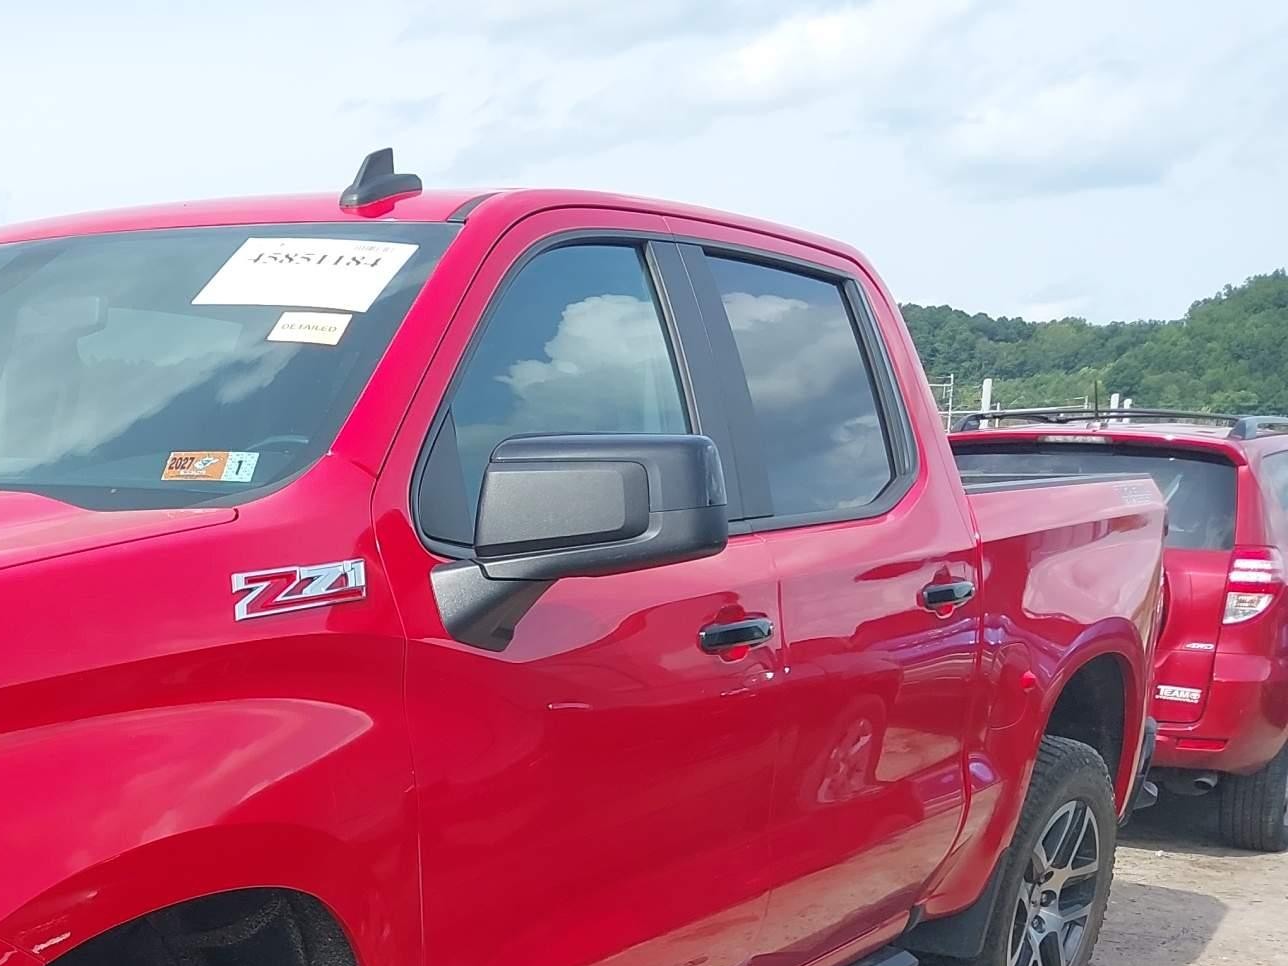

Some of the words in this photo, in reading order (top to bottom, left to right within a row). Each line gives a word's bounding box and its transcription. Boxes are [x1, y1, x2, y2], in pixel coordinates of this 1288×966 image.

[248, 252, 382, 268] 45851184
[281, 323, 337, 333] DETAILED
[168, 456, 195, 470] 2027
[231, 558, 366, 621] Z71
